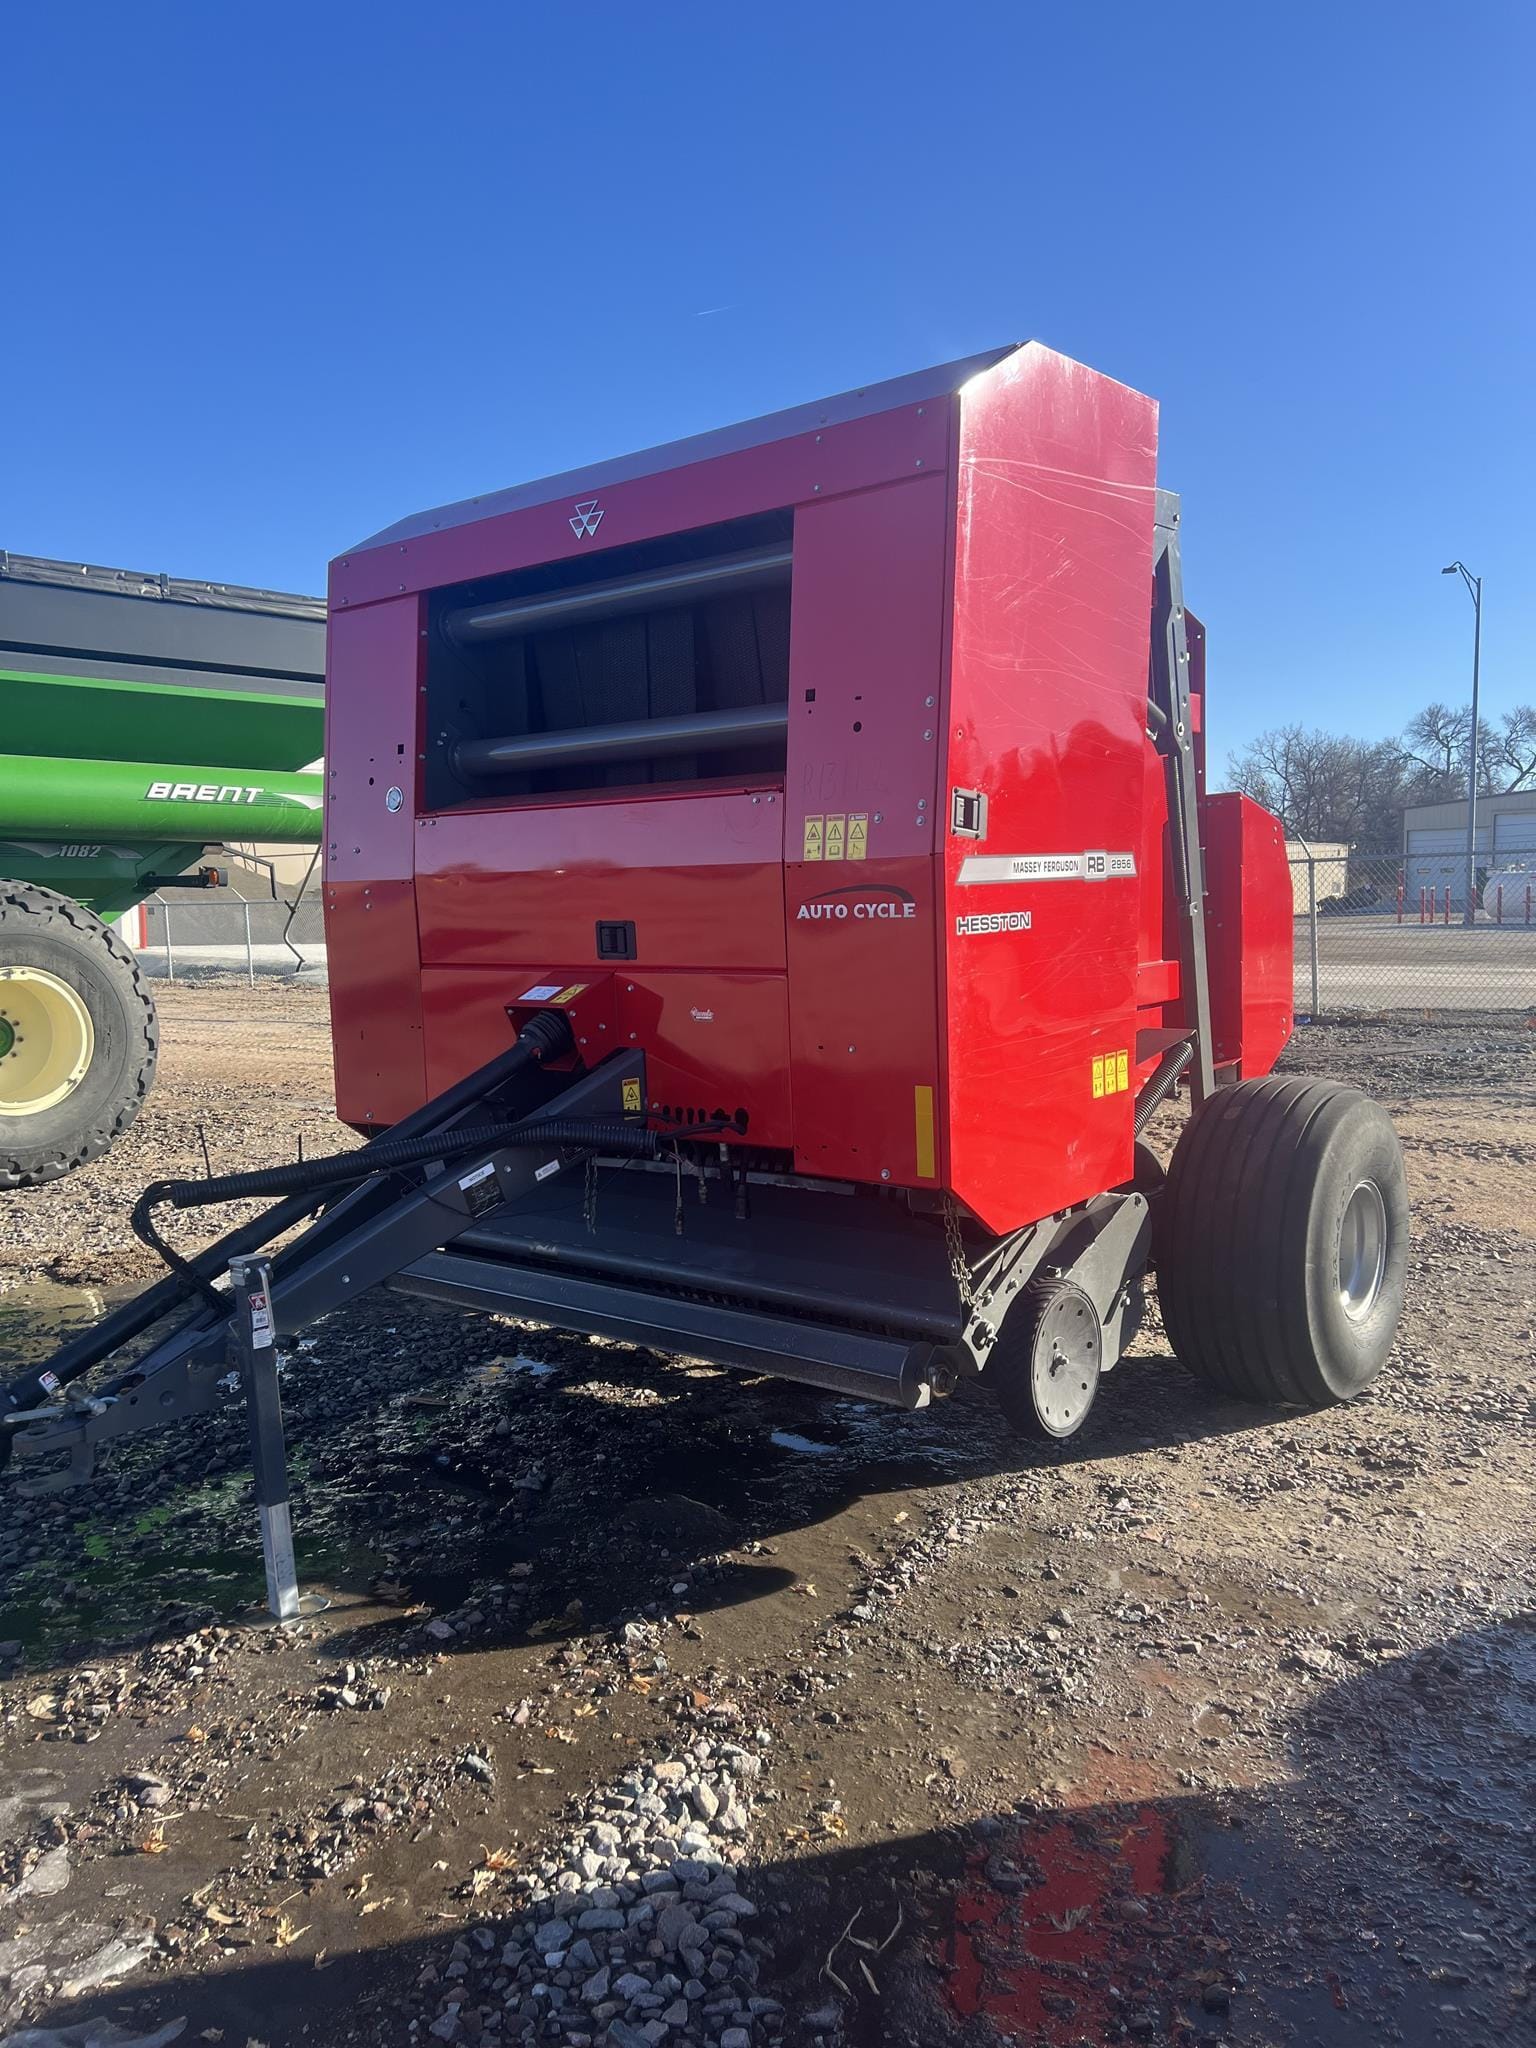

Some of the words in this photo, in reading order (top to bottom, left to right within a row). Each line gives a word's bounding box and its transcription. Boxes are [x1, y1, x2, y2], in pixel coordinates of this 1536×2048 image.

[147, 782, 264, 803] BRENT
[59, 844, 102, 858] 1082
[1012, 860, 1042, 874] MASSEY
[1043, 859, 1079, 873] FERGUSON
[1087, 856, 1105, 873] RB
[1110, 858, 1132, 870] 2956
[796, 904, 849, 920] AUTO
[853, 902, 917, 919] CYCLE
[957, 912, 1031, 935] HESSTON
